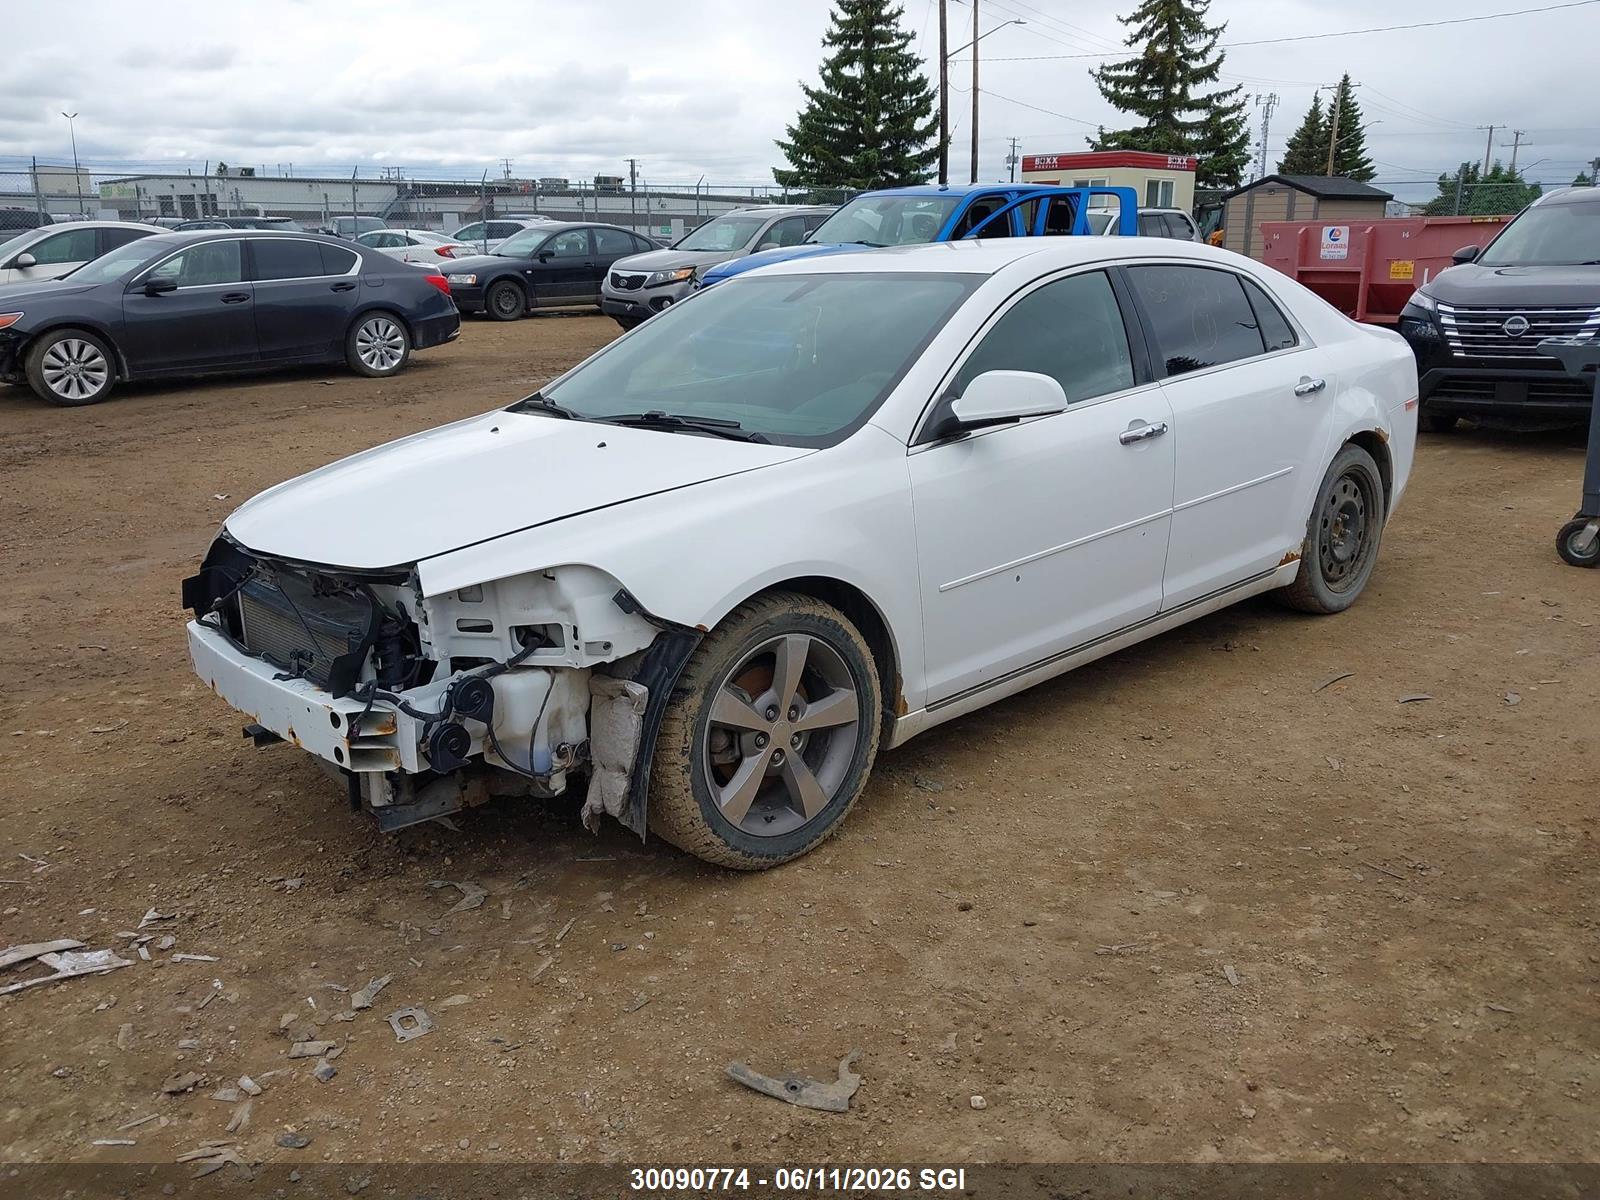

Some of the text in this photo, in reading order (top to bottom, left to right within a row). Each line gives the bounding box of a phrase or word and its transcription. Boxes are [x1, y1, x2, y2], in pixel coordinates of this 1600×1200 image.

[1034, 156, 1059, 165] BOXX
[1167, 156, 1188, 165] BOXX
[1321, 242, 1347, 250] Loraas
